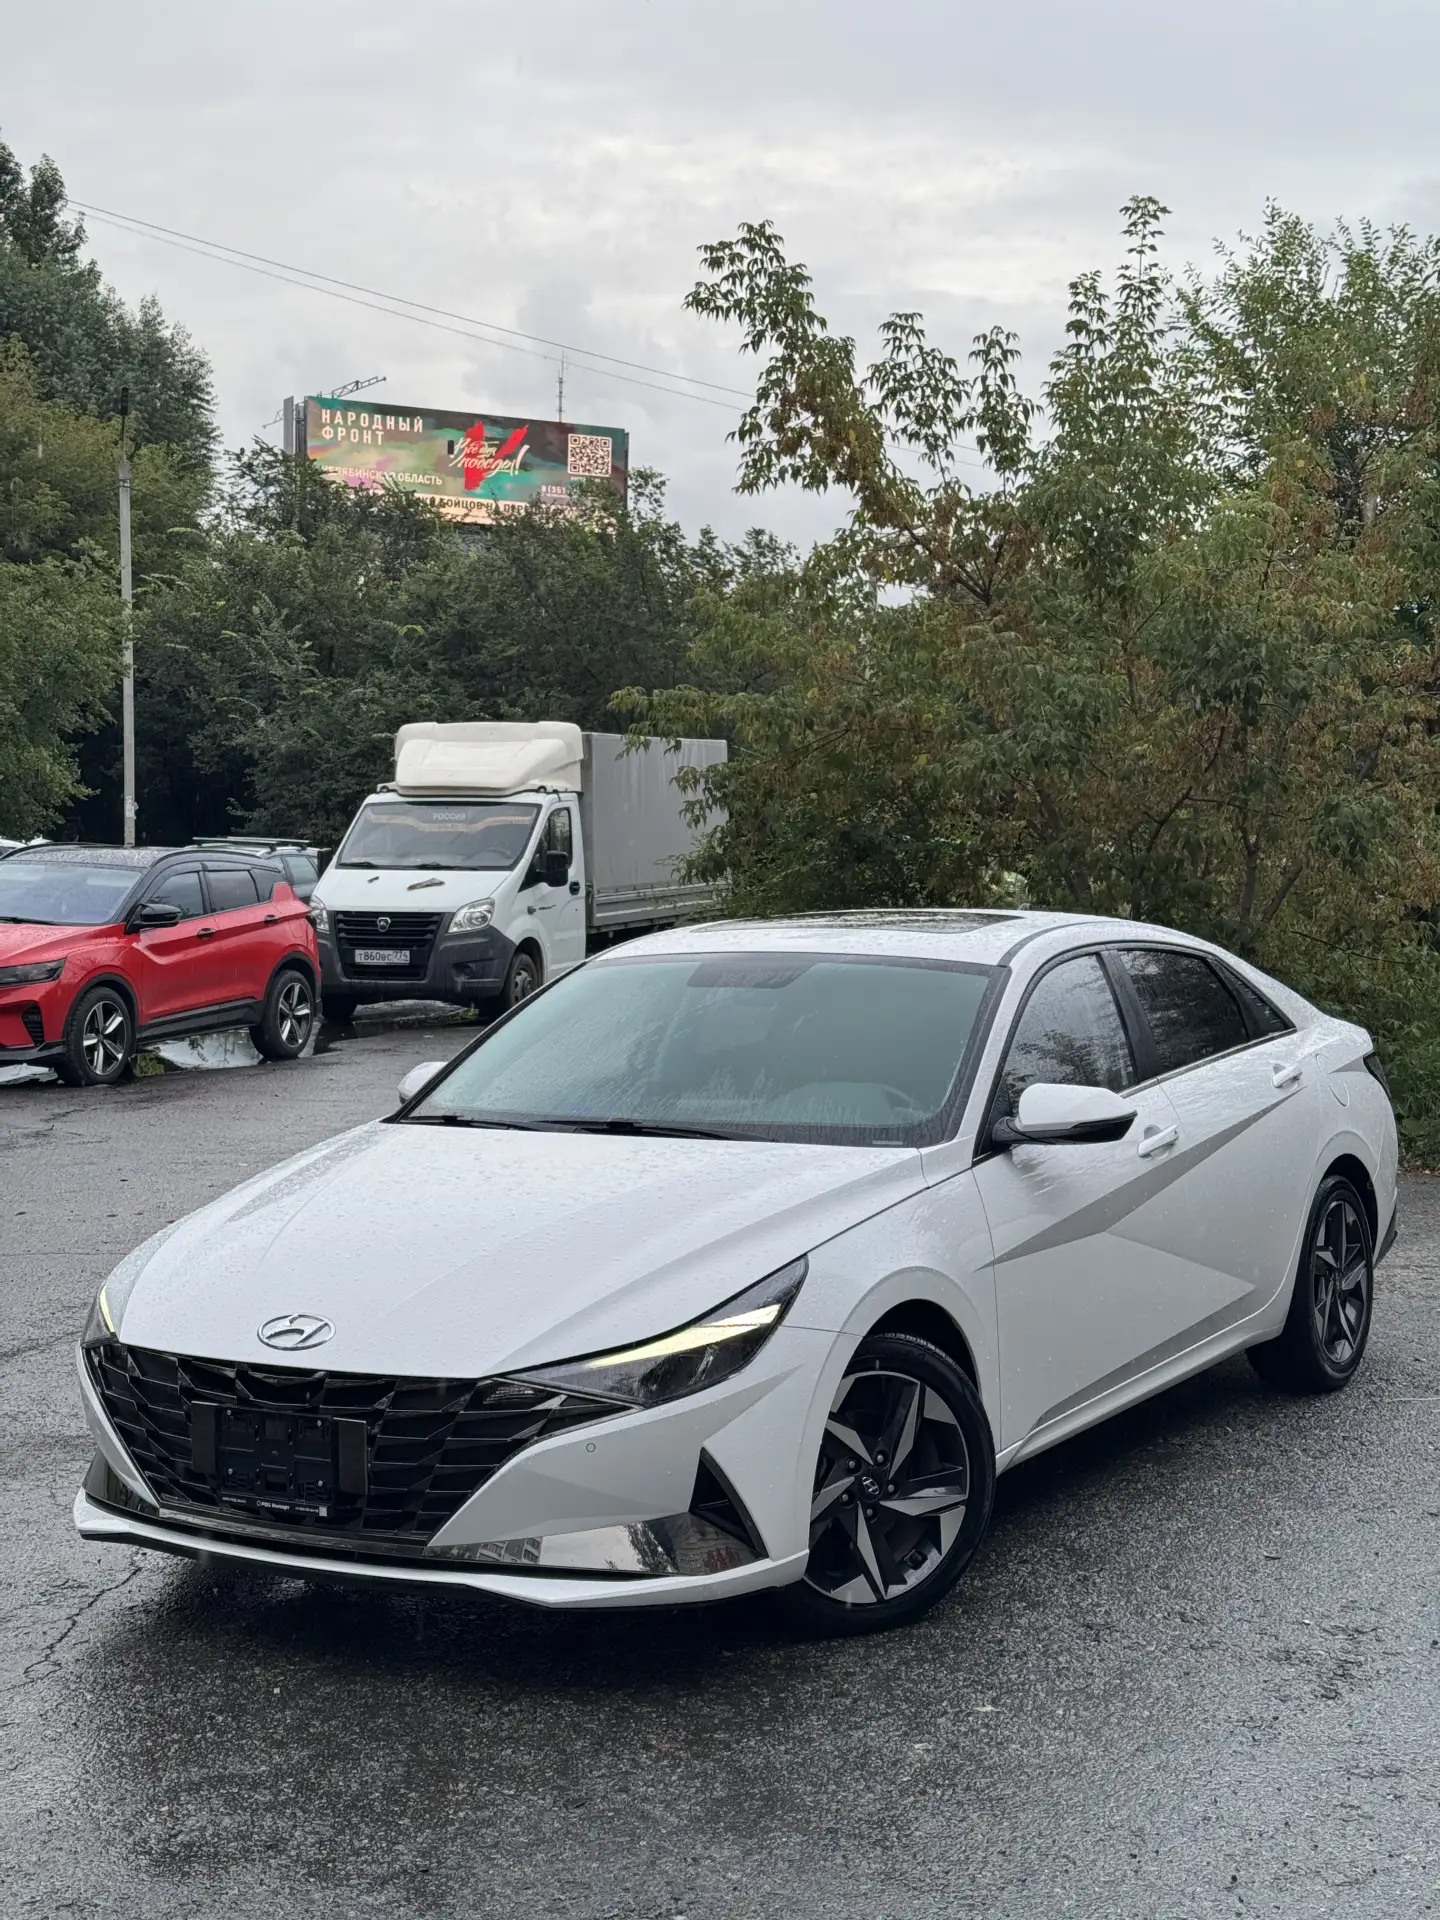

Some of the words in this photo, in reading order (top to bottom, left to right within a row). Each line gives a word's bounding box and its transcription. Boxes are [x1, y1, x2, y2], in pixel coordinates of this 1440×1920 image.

[321, 409, 423, 433] НАРОДНЫЙ
[321, 425, 384, 445] ФРОНТ
[398, 472, 443, 485] ОБЛАСТЬ
[440, 497, 483, 510] БОЙЦОВ
[432, 812, 466, 820] РОССИЯ
[394, 951, 409, 960] 774
